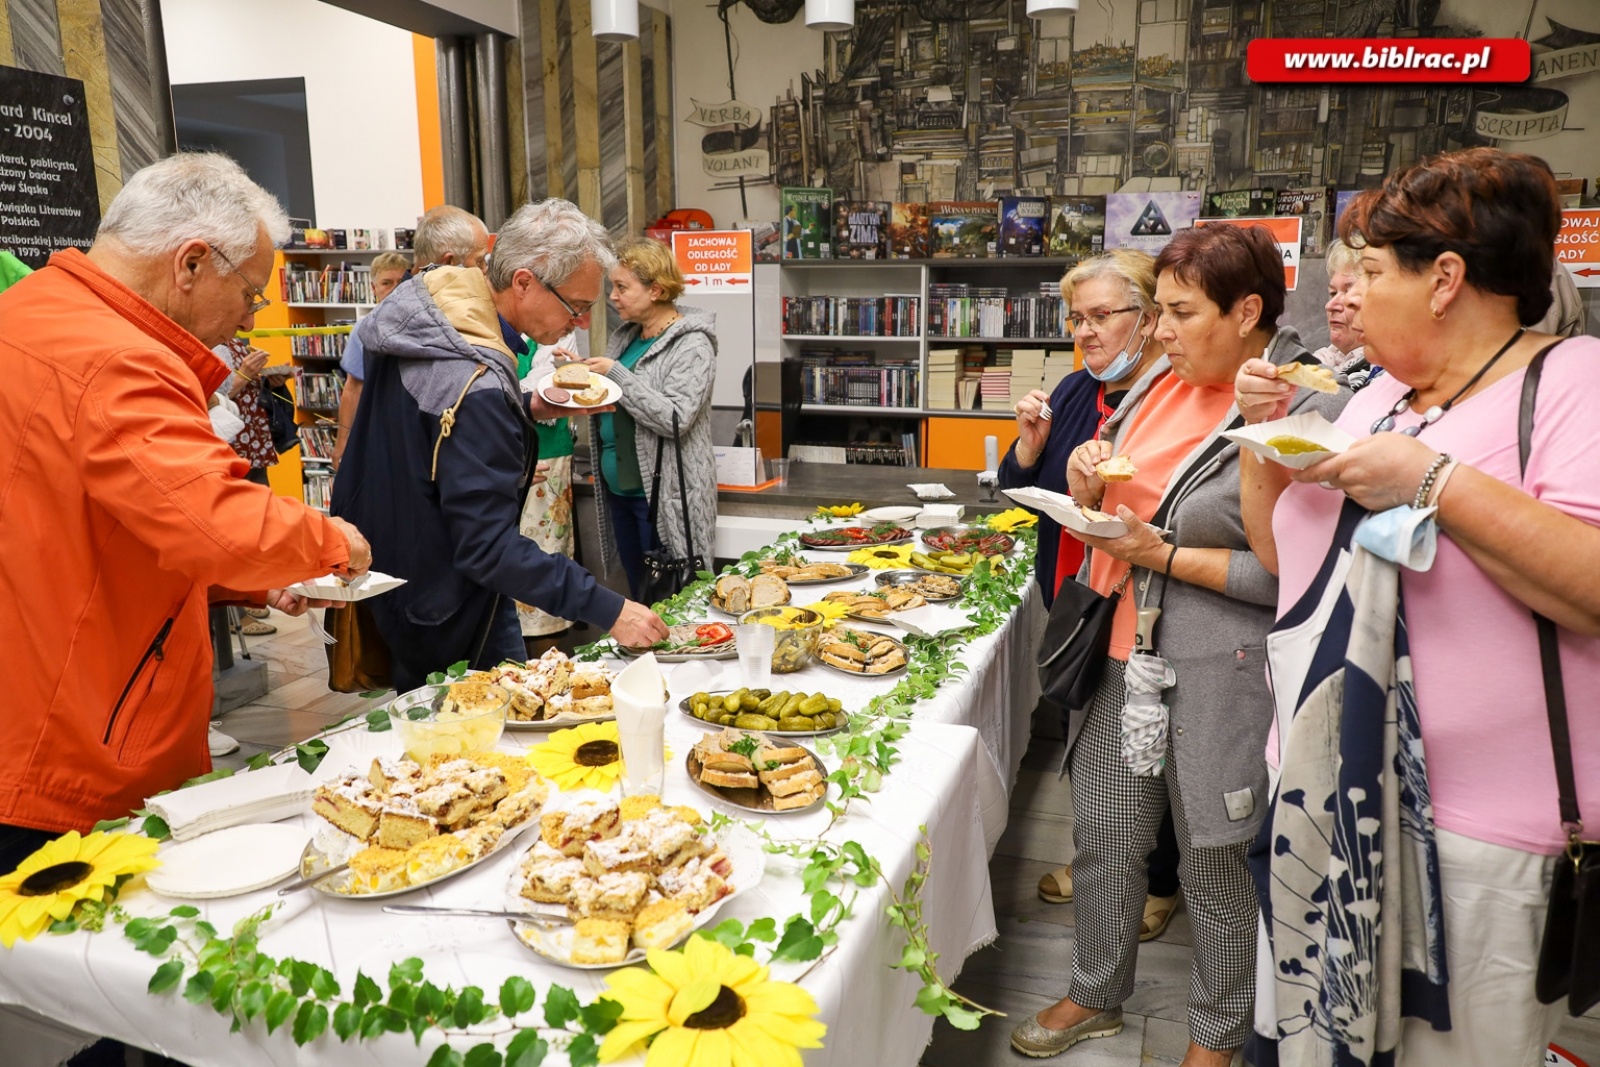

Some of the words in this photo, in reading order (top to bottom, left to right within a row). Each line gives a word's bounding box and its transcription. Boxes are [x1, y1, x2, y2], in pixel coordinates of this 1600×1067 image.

[32, 106, 72, 126] Kincel
[700, 106, 751, 124] VERBA
[13, 123, 53, 141] 2004
[1478, 115, 1559, 136] SCRIPTA
[30, 157, 78, 172] publicysta,
[704, 156, 764, 172] VOLANT
[28, 169, 61, 181] badacz
[18, 181, 49, 195] Śląska
[39, 204, 81, 217] Literatów
[1, 216, 40, 227] Polskich
[849, 225, 879, 244] ZIMA
[688, 237, 737, 247] ZACHOWAJ
[18, 247, 40, 257] 1979
[687, 248, 739, 259] ODLEGŁOŚĆ
[694, 263, 708, 271] OD
[710, 262, 731, 272] LADY
[712, 278, 722, 286] m
